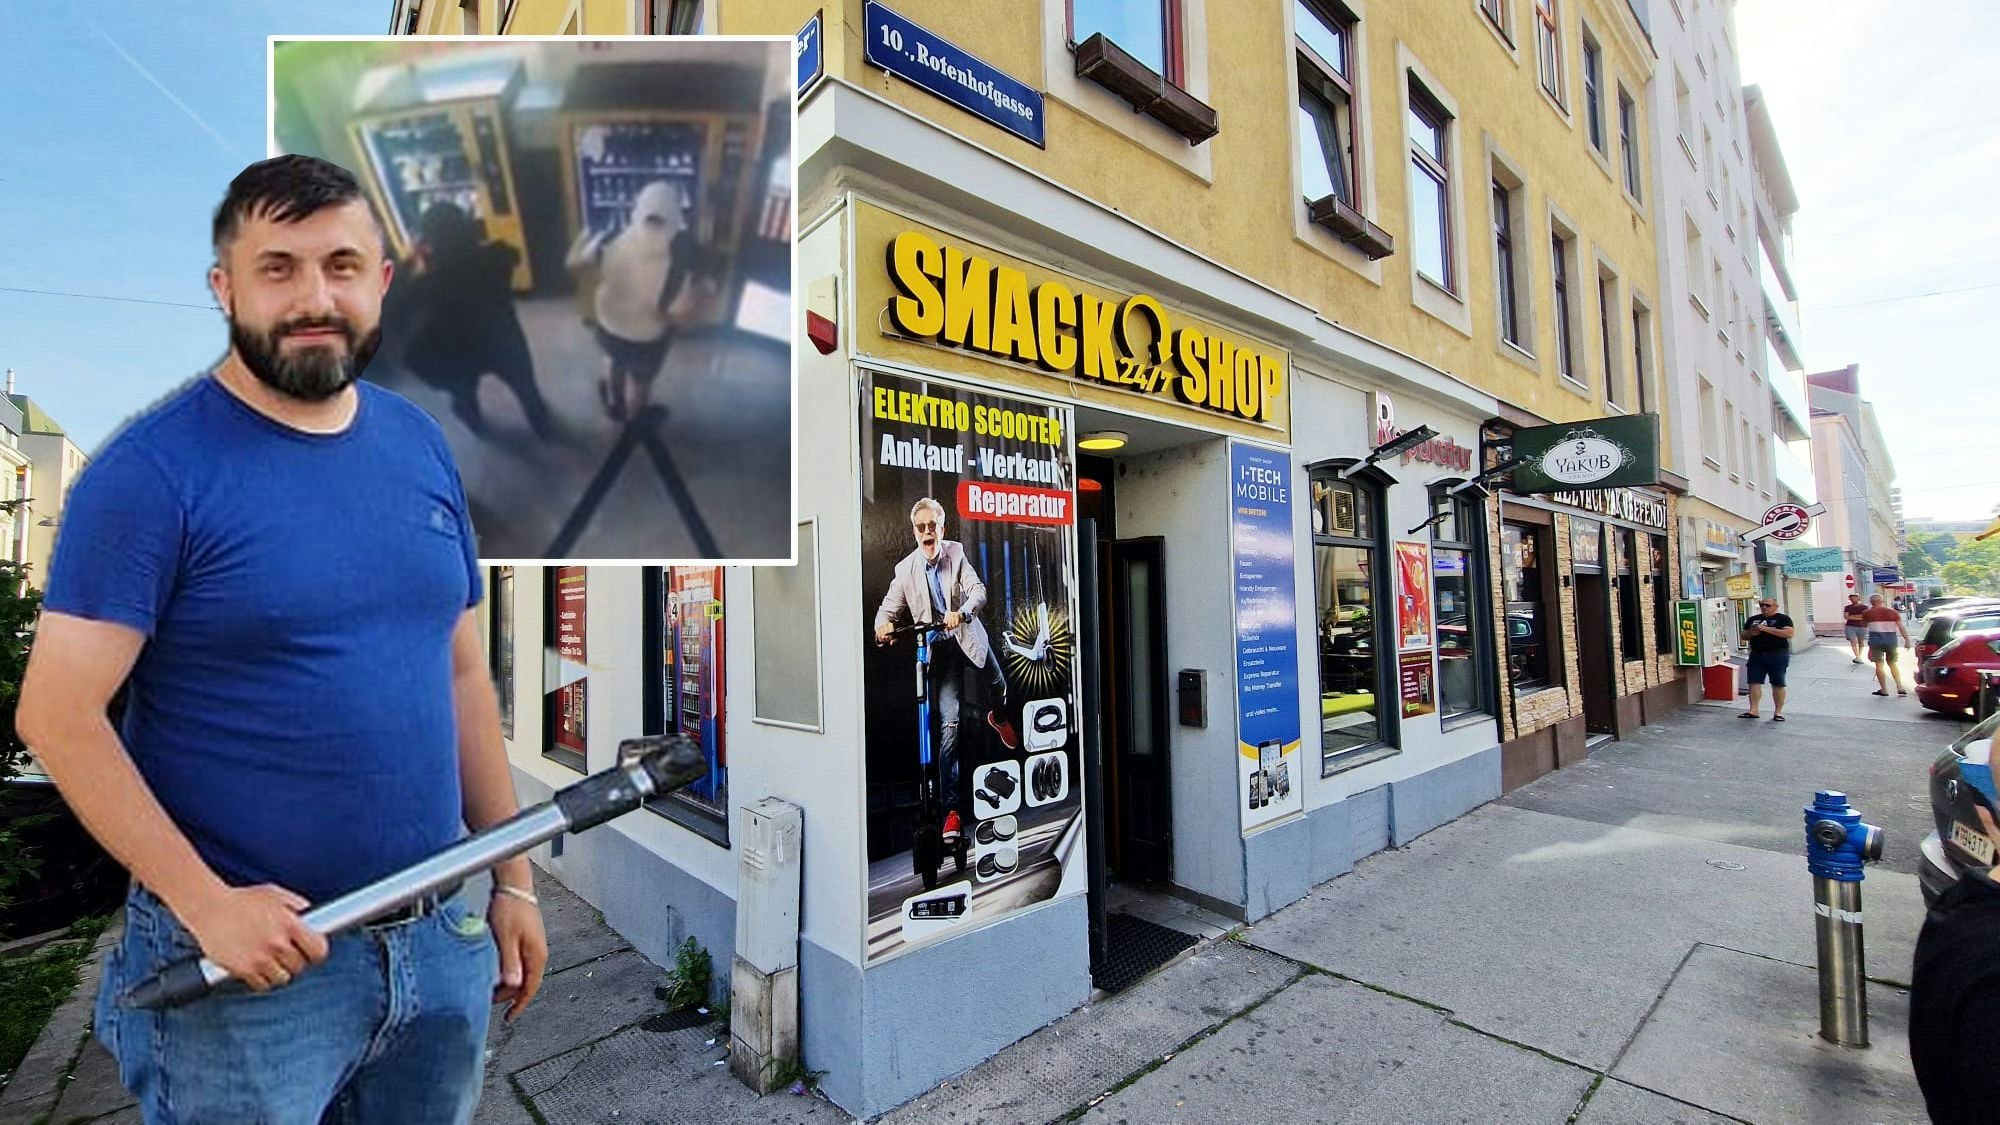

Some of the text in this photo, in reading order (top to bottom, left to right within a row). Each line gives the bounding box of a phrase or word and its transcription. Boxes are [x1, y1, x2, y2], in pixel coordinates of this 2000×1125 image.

[916, 41, 1034, 121] Rotenhofgasse
[1119, 357, 1173, 393] 24/7
[1174, 326, 1281, 422] SHOP
[874, 386, 1062, 447] ELEKTRO SCOOTER
[880, 433, 964, 474] Ankauf
[979, 446, 1059, 484] Verkauf
[1241, 465, 1281, 486] I-TECH
[1556, 454, 1611, 473] YAKUB
[968, 485, 1066, 519] Reparatur
[1237, 482, 1287, 504] MOBILE
